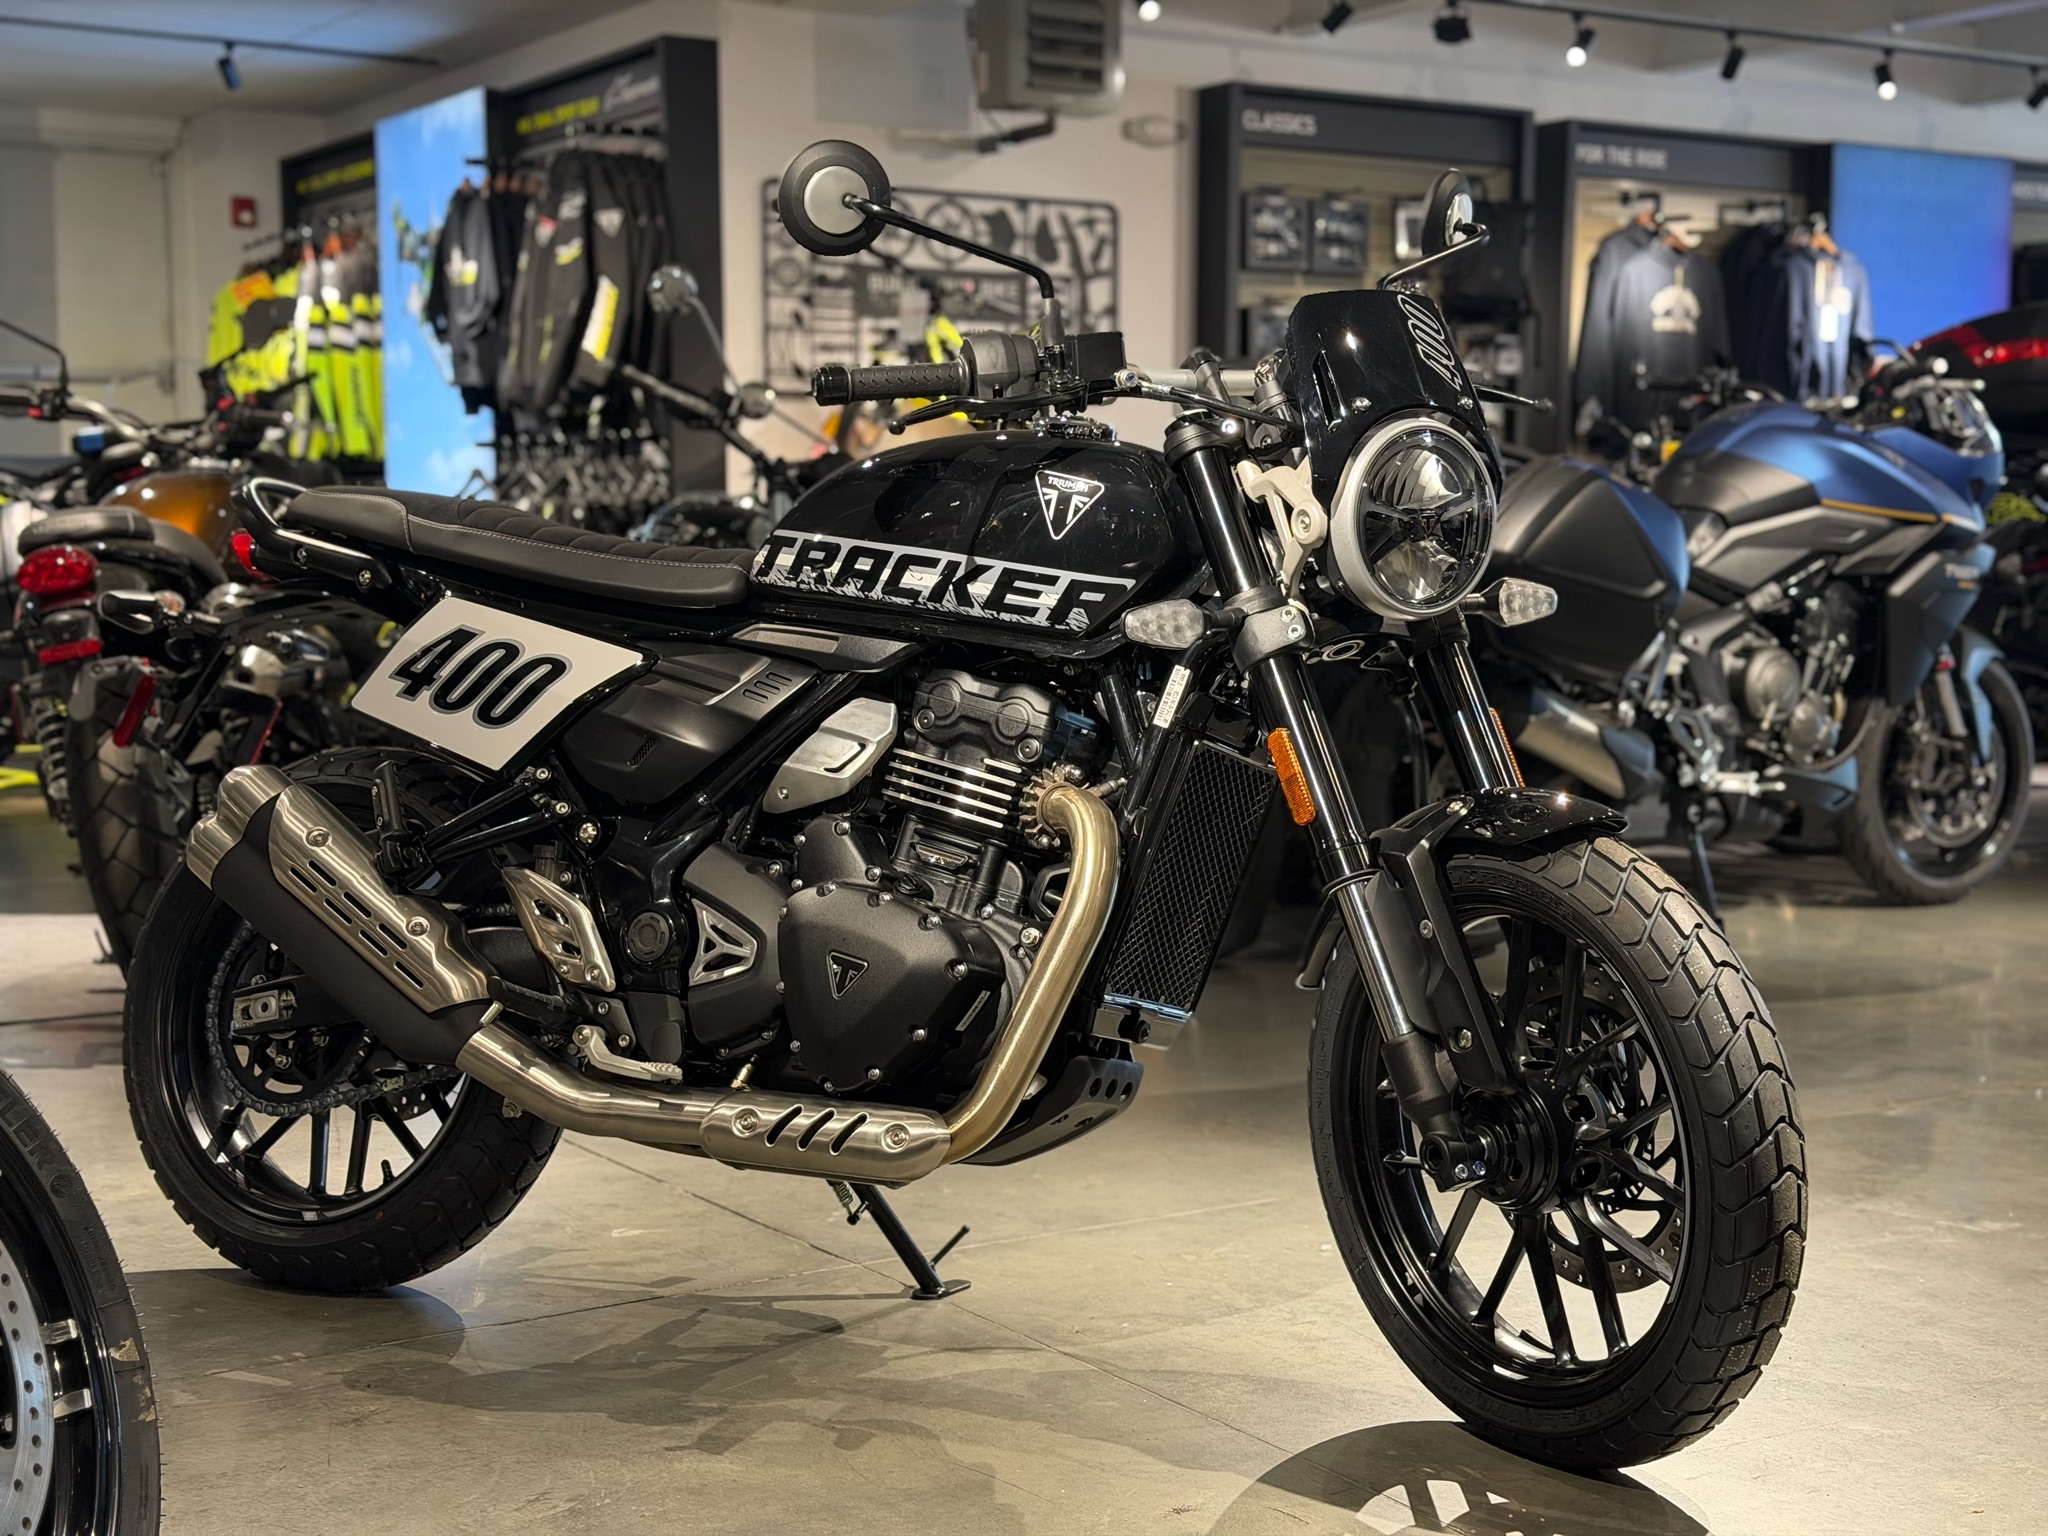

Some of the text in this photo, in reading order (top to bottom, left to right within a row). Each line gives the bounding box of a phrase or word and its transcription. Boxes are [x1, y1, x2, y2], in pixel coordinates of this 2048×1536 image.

[1396, 294, 1463, 392] 400
[1047, 476, 1089, 493] TRIUMPH
[753, 534, 1127, 629] TRACKER
[387, 623, 573, 730] 400
